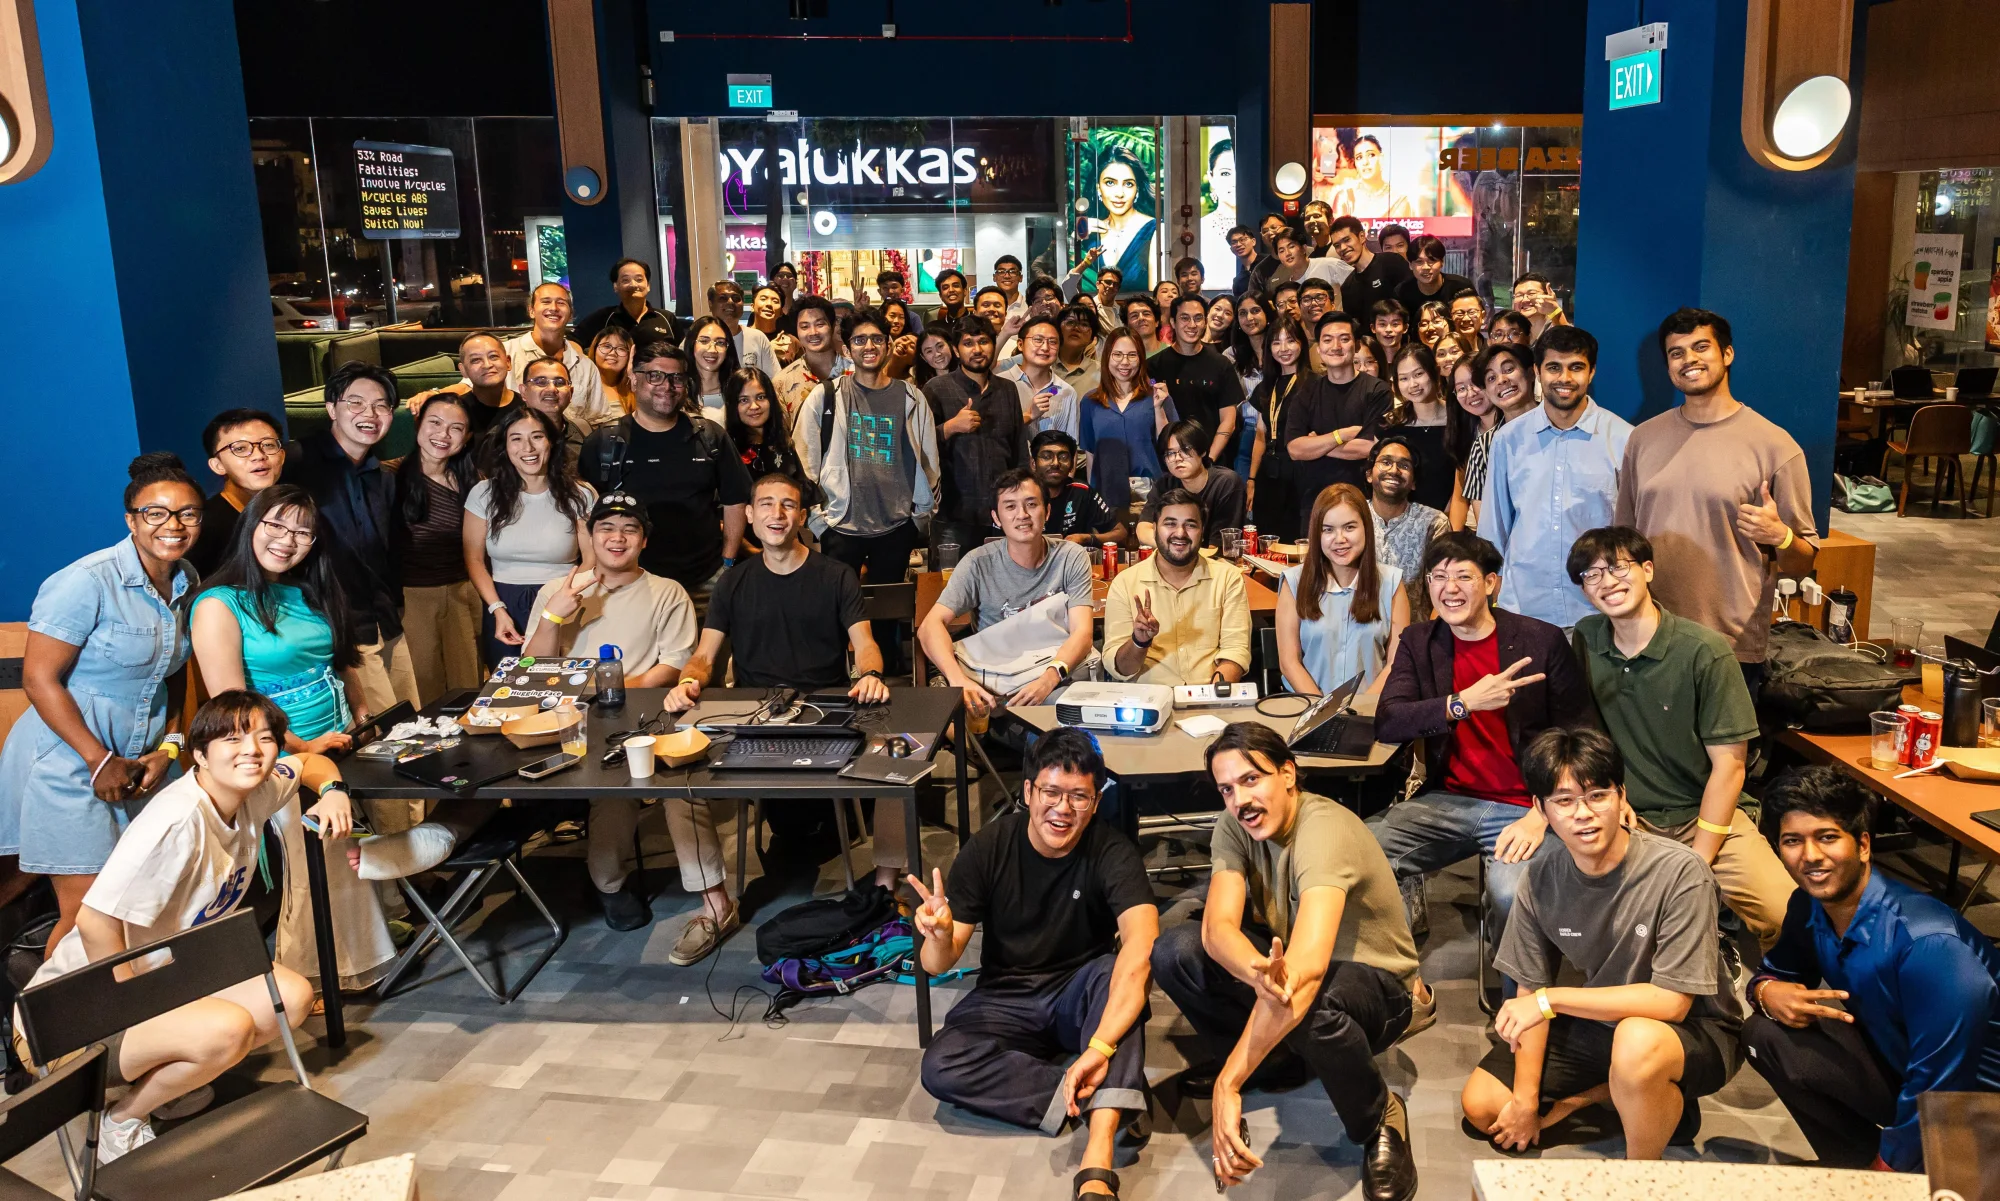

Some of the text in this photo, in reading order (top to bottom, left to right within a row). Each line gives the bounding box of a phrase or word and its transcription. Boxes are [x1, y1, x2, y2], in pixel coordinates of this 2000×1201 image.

[1615, 62, 1645, 100] EXIT
[737, 89, 763, 104] EXIT
[357, 150, 403, 163] 53% Road
[358, 163, 418, 177] Fatalities:
[361, 177, 446, 191] Involve M/cycles
[361, 191, 428, 204] M/cycles ABS
[363, 205, 428, 216] Saves Lives:
[364, 218, 424, 229] Switch Now!
[1931, 269, 1954, 277] sparkling
[1911, 300, 1937, 309] strawberry
[510, 689, 543, 697] Hugging
